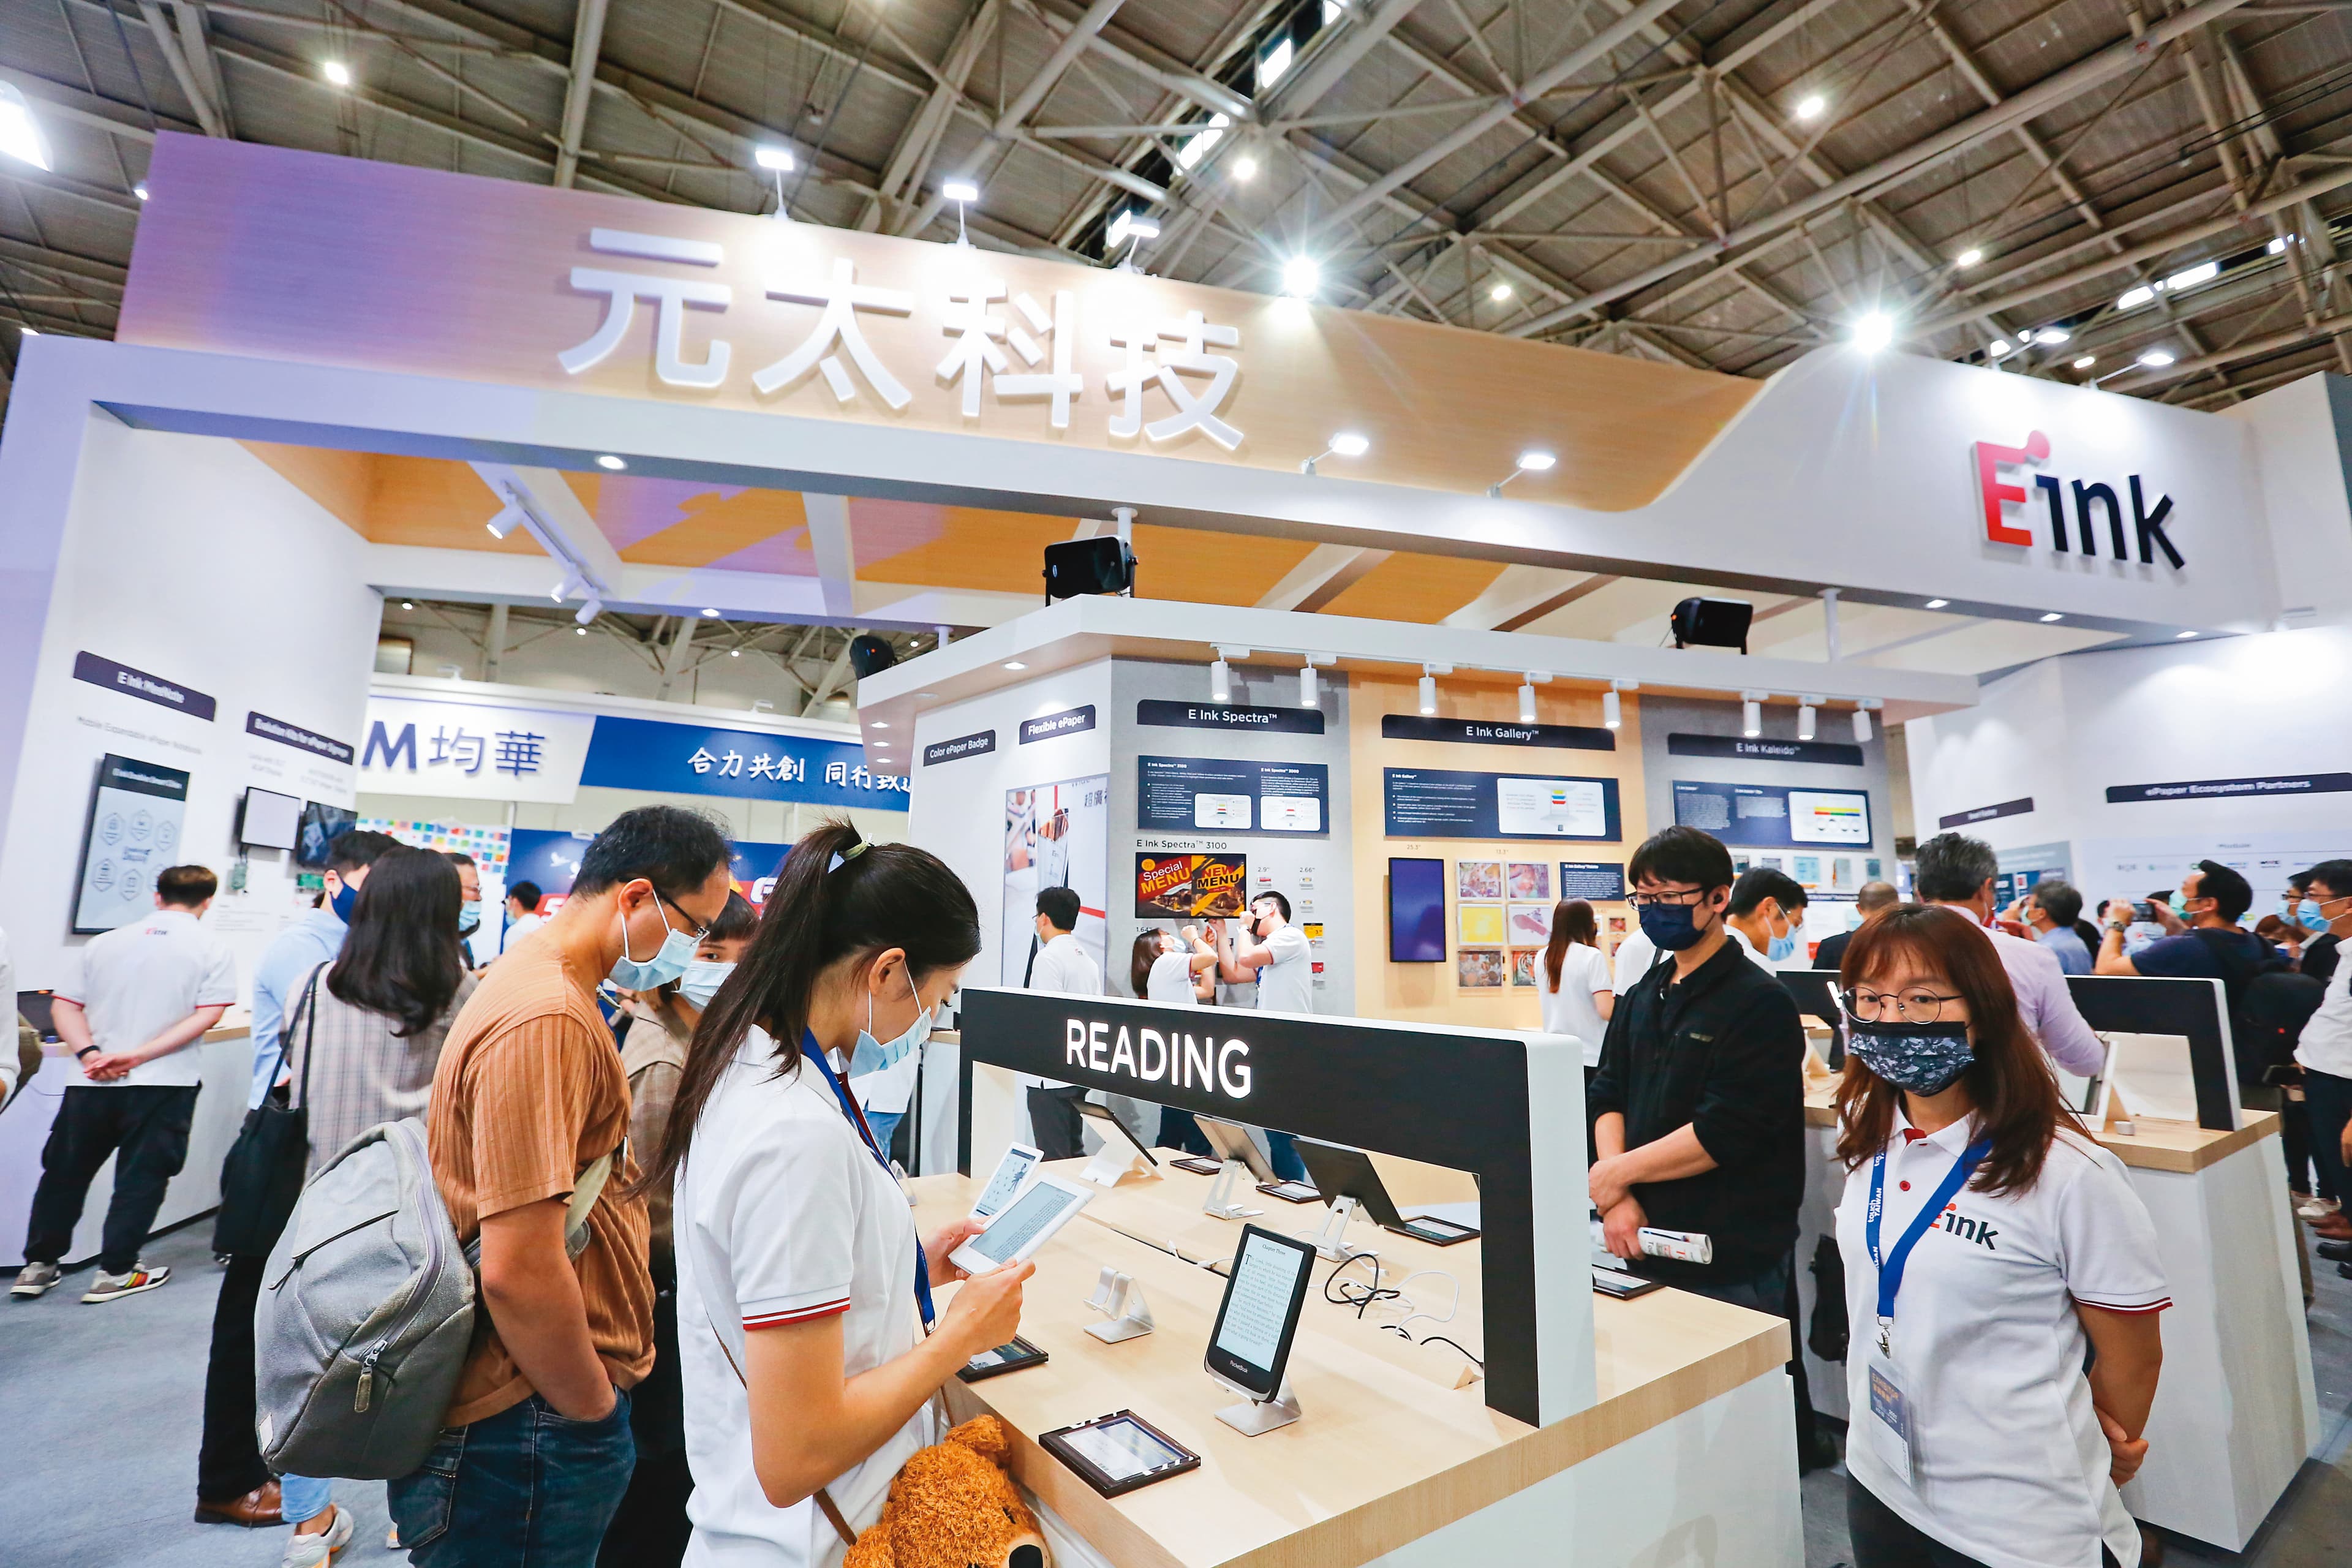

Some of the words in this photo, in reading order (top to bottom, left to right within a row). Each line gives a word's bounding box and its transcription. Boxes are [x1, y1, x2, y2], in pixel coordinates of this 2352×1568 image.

[556, 227, 1244, 450] 元太科技
[1028, 719, 1057, 736] Flexible
[1058, 714, 1085, 729] ePaper
[1188, 709, 1196, 719] E
[1200, 709, 1219, 721] Ink
[1466, 726, 1473, 736] E
[1476, 726, 1493, 737] Ink
[429, 725, 545, 776] 均華
[930, 747, 945, 759] Color
[946, 741, 967, 756] ePaper
[968, 737, 989, 750] Badge
[1736, 743, 1743, 752] E
[1746, 743, 1760, 753] Ink
[687, 747, 805, 783] 合力共創
[1141, 867, 1190, 894] MENU
[1144, 861, 1183, 882] Special
[1197, 874, 1240, 889] MENU
[1202, 865, 1235, 878] NEW
[1066, 1019, 1251, 1099] READING
[1868, 1199, 1877, 1223] touch
[1262, 1244, 1275, 1253] Chapter
[1230, 1360, 1248, 1374] PocketBook
